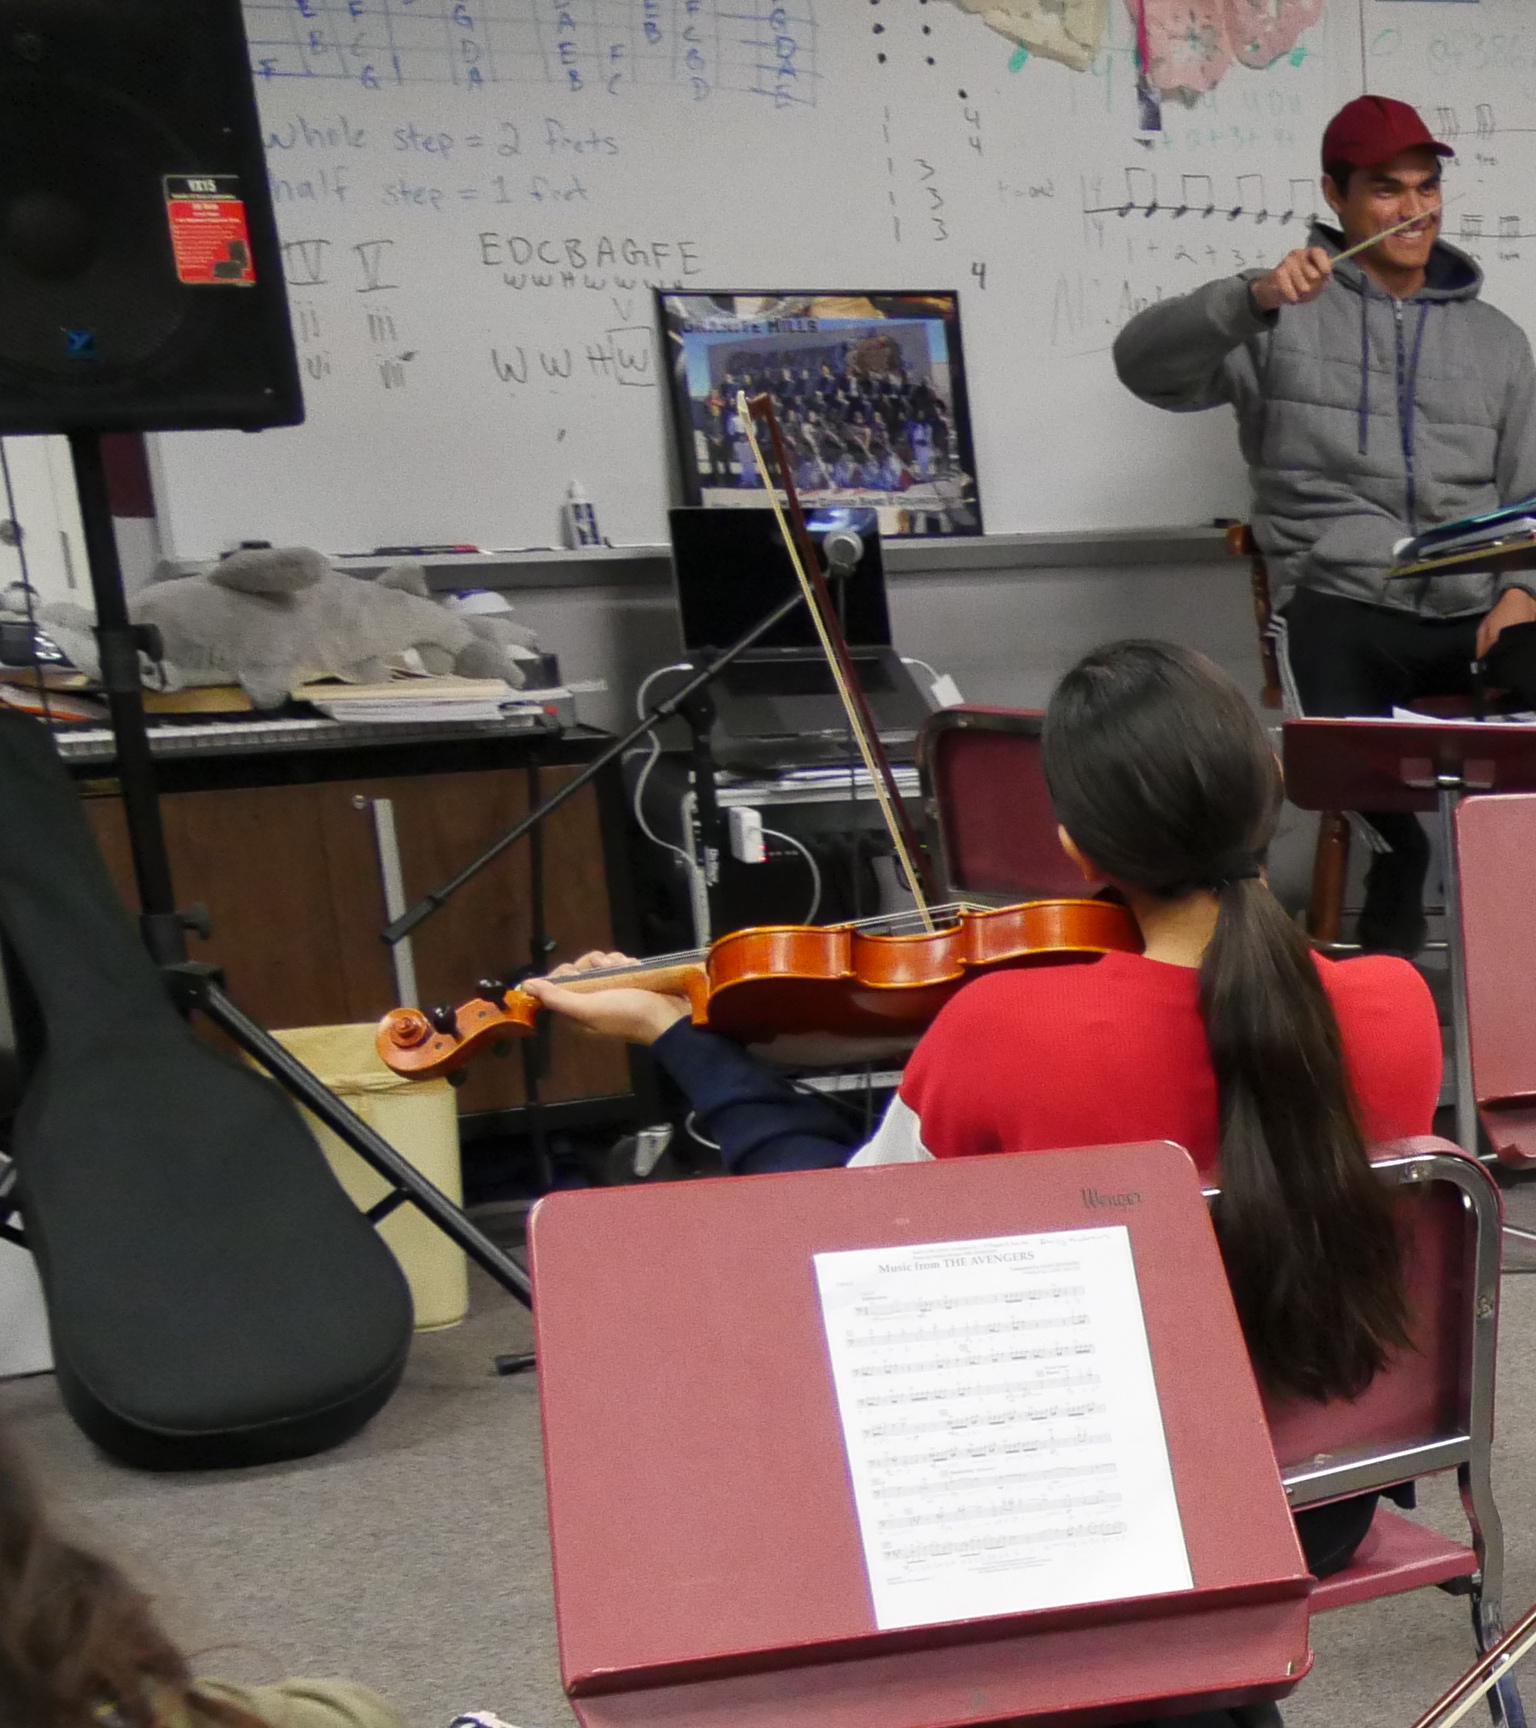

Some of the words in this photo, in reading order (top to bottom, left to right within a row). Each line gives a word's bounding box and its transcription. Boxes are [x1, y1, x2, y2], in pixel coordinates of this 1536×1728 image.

[393, 122, 454, 160] step
[496, 121, 521, 157] 2
[878, 1261, 913, 1274] Music
[914, 1259, 941, 1271] from
[943, 1257, 968, 1269] THE
[970, 1250, 1035, 1266] AVENGERS
